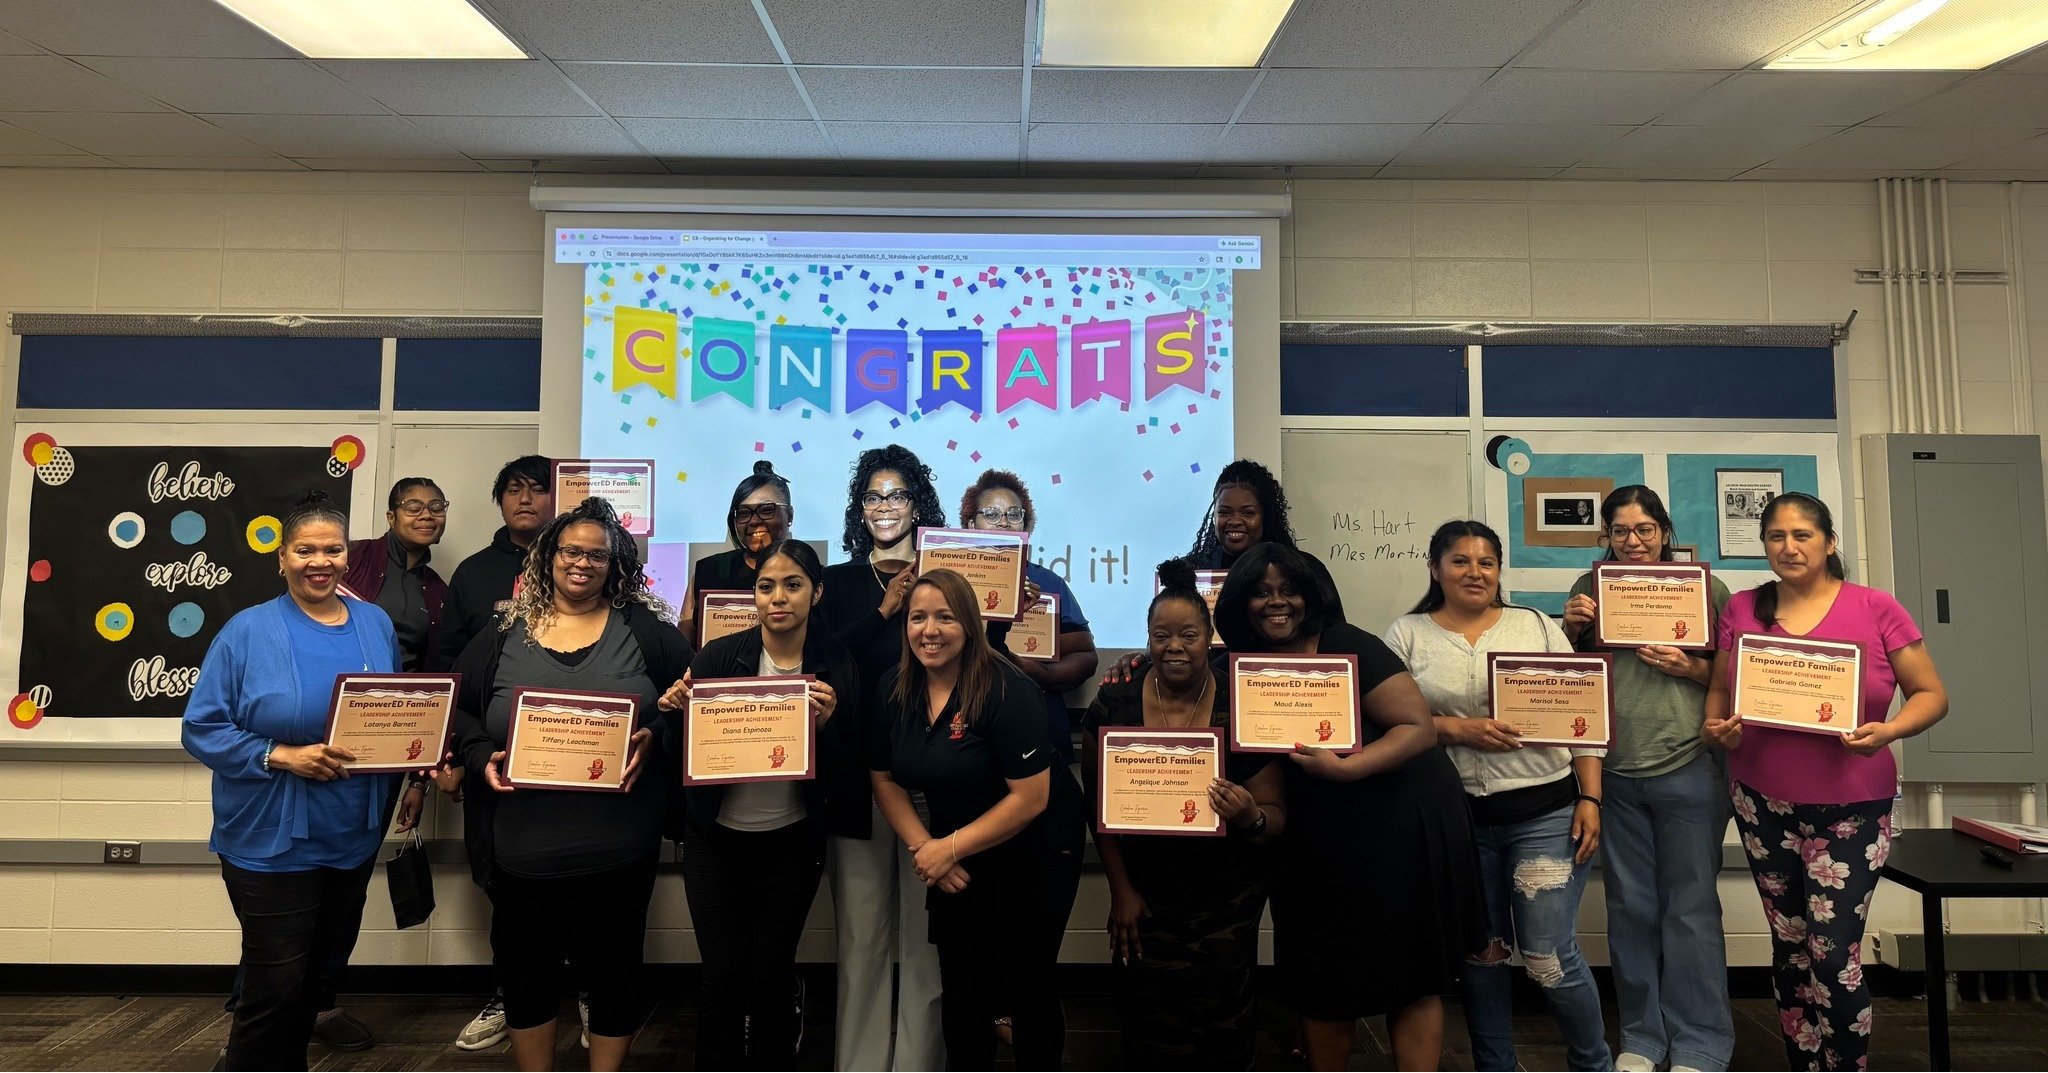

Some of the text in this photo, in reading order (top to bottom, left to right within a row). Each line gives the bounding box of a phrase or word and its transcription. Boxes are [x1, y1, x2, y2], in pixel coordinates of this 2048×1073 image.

[625, 331, 1195, 391] CONGRATS
[148, 461, 235, 503] believe
[1333, 509, 1415, 536] Ms. Hart
[930, 551, 1010, 563] EmpowerED Families
[1028, 544, 1129, 585] id it!
[145, 551, 232, 592] explore
[1609, 584, 1694, 593] EmpowerED Families
[1749, 655, 1846, 673] EmpowerED Families
[128, 655, 200, 701] blesse
[1761, 668, 1831, 680] LEADERSHIP ACHIEVEMENT
[1247, 679, 1340, 688] EmpowerED Families
[1505, 677, 1595, 687] EmpowerED Families
[1769, 678, 1822, 689] Gabriela Gomez
[349, 700, 440, 709] EmpowerED Families
[701, 703, 796, 715] EmpowerED Families
[364, 721, 391, 729] Latonya
[528, 714, 619, 728] EmpowerED Families
[539, 726, 569, 734] LEADERSHIP
[743, 726, 772, 735] Espinoza
[542, 736, 599, 746] Tiffany Leachman
[1114, 755, 1206, 765] EmpowerED Families
[1130, 778, 1160, 787] Angelique
